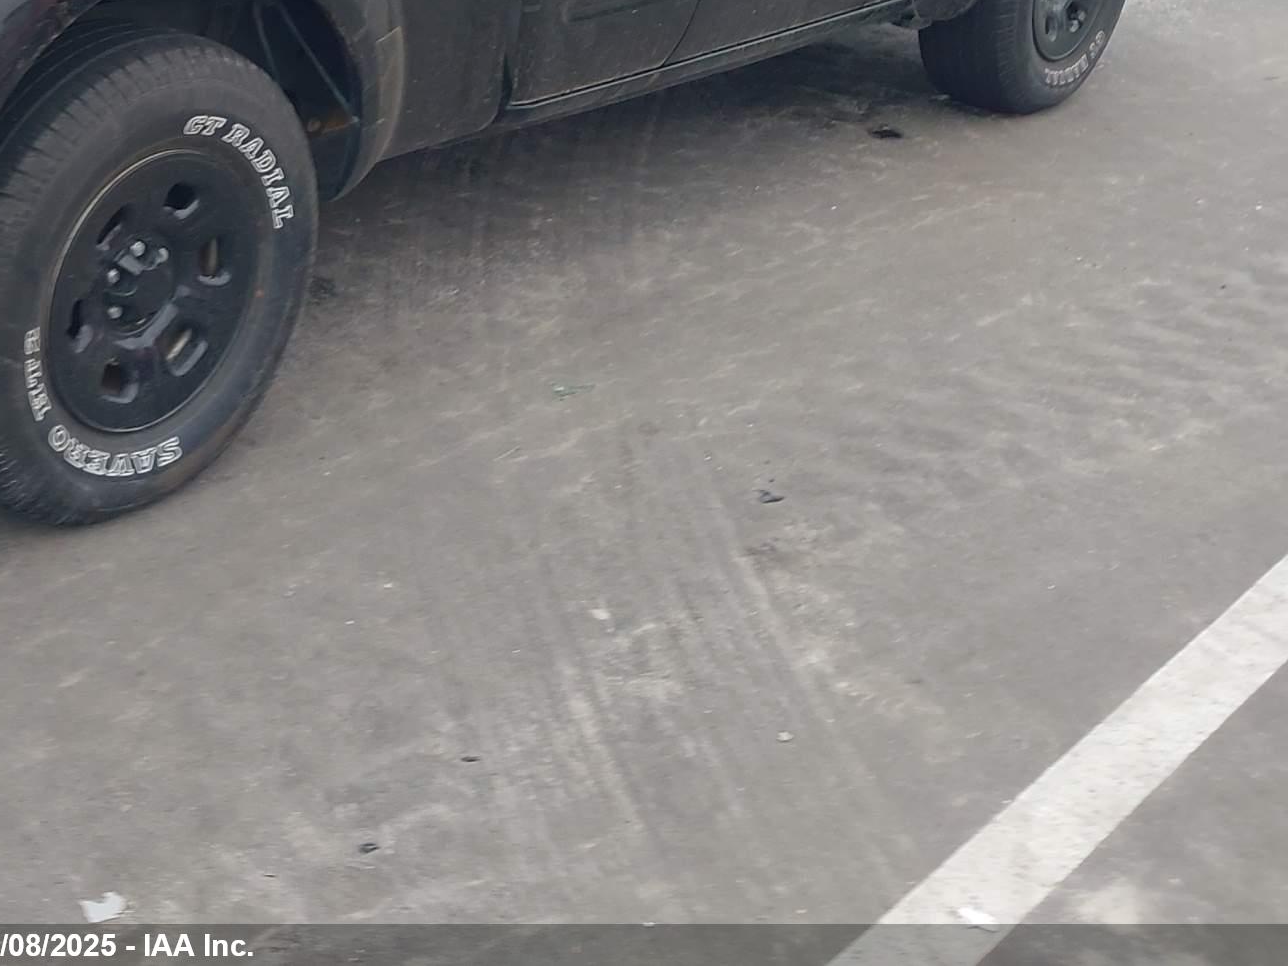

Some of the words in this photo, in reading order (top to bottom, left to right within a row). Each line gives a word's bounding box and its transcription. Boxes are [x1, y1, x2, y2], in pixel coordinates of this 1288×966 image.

[183, 115, 228, 136] GT
[220, 123, 294, 229] RADIAL
[48, 424, 183, 477] SAVERO
